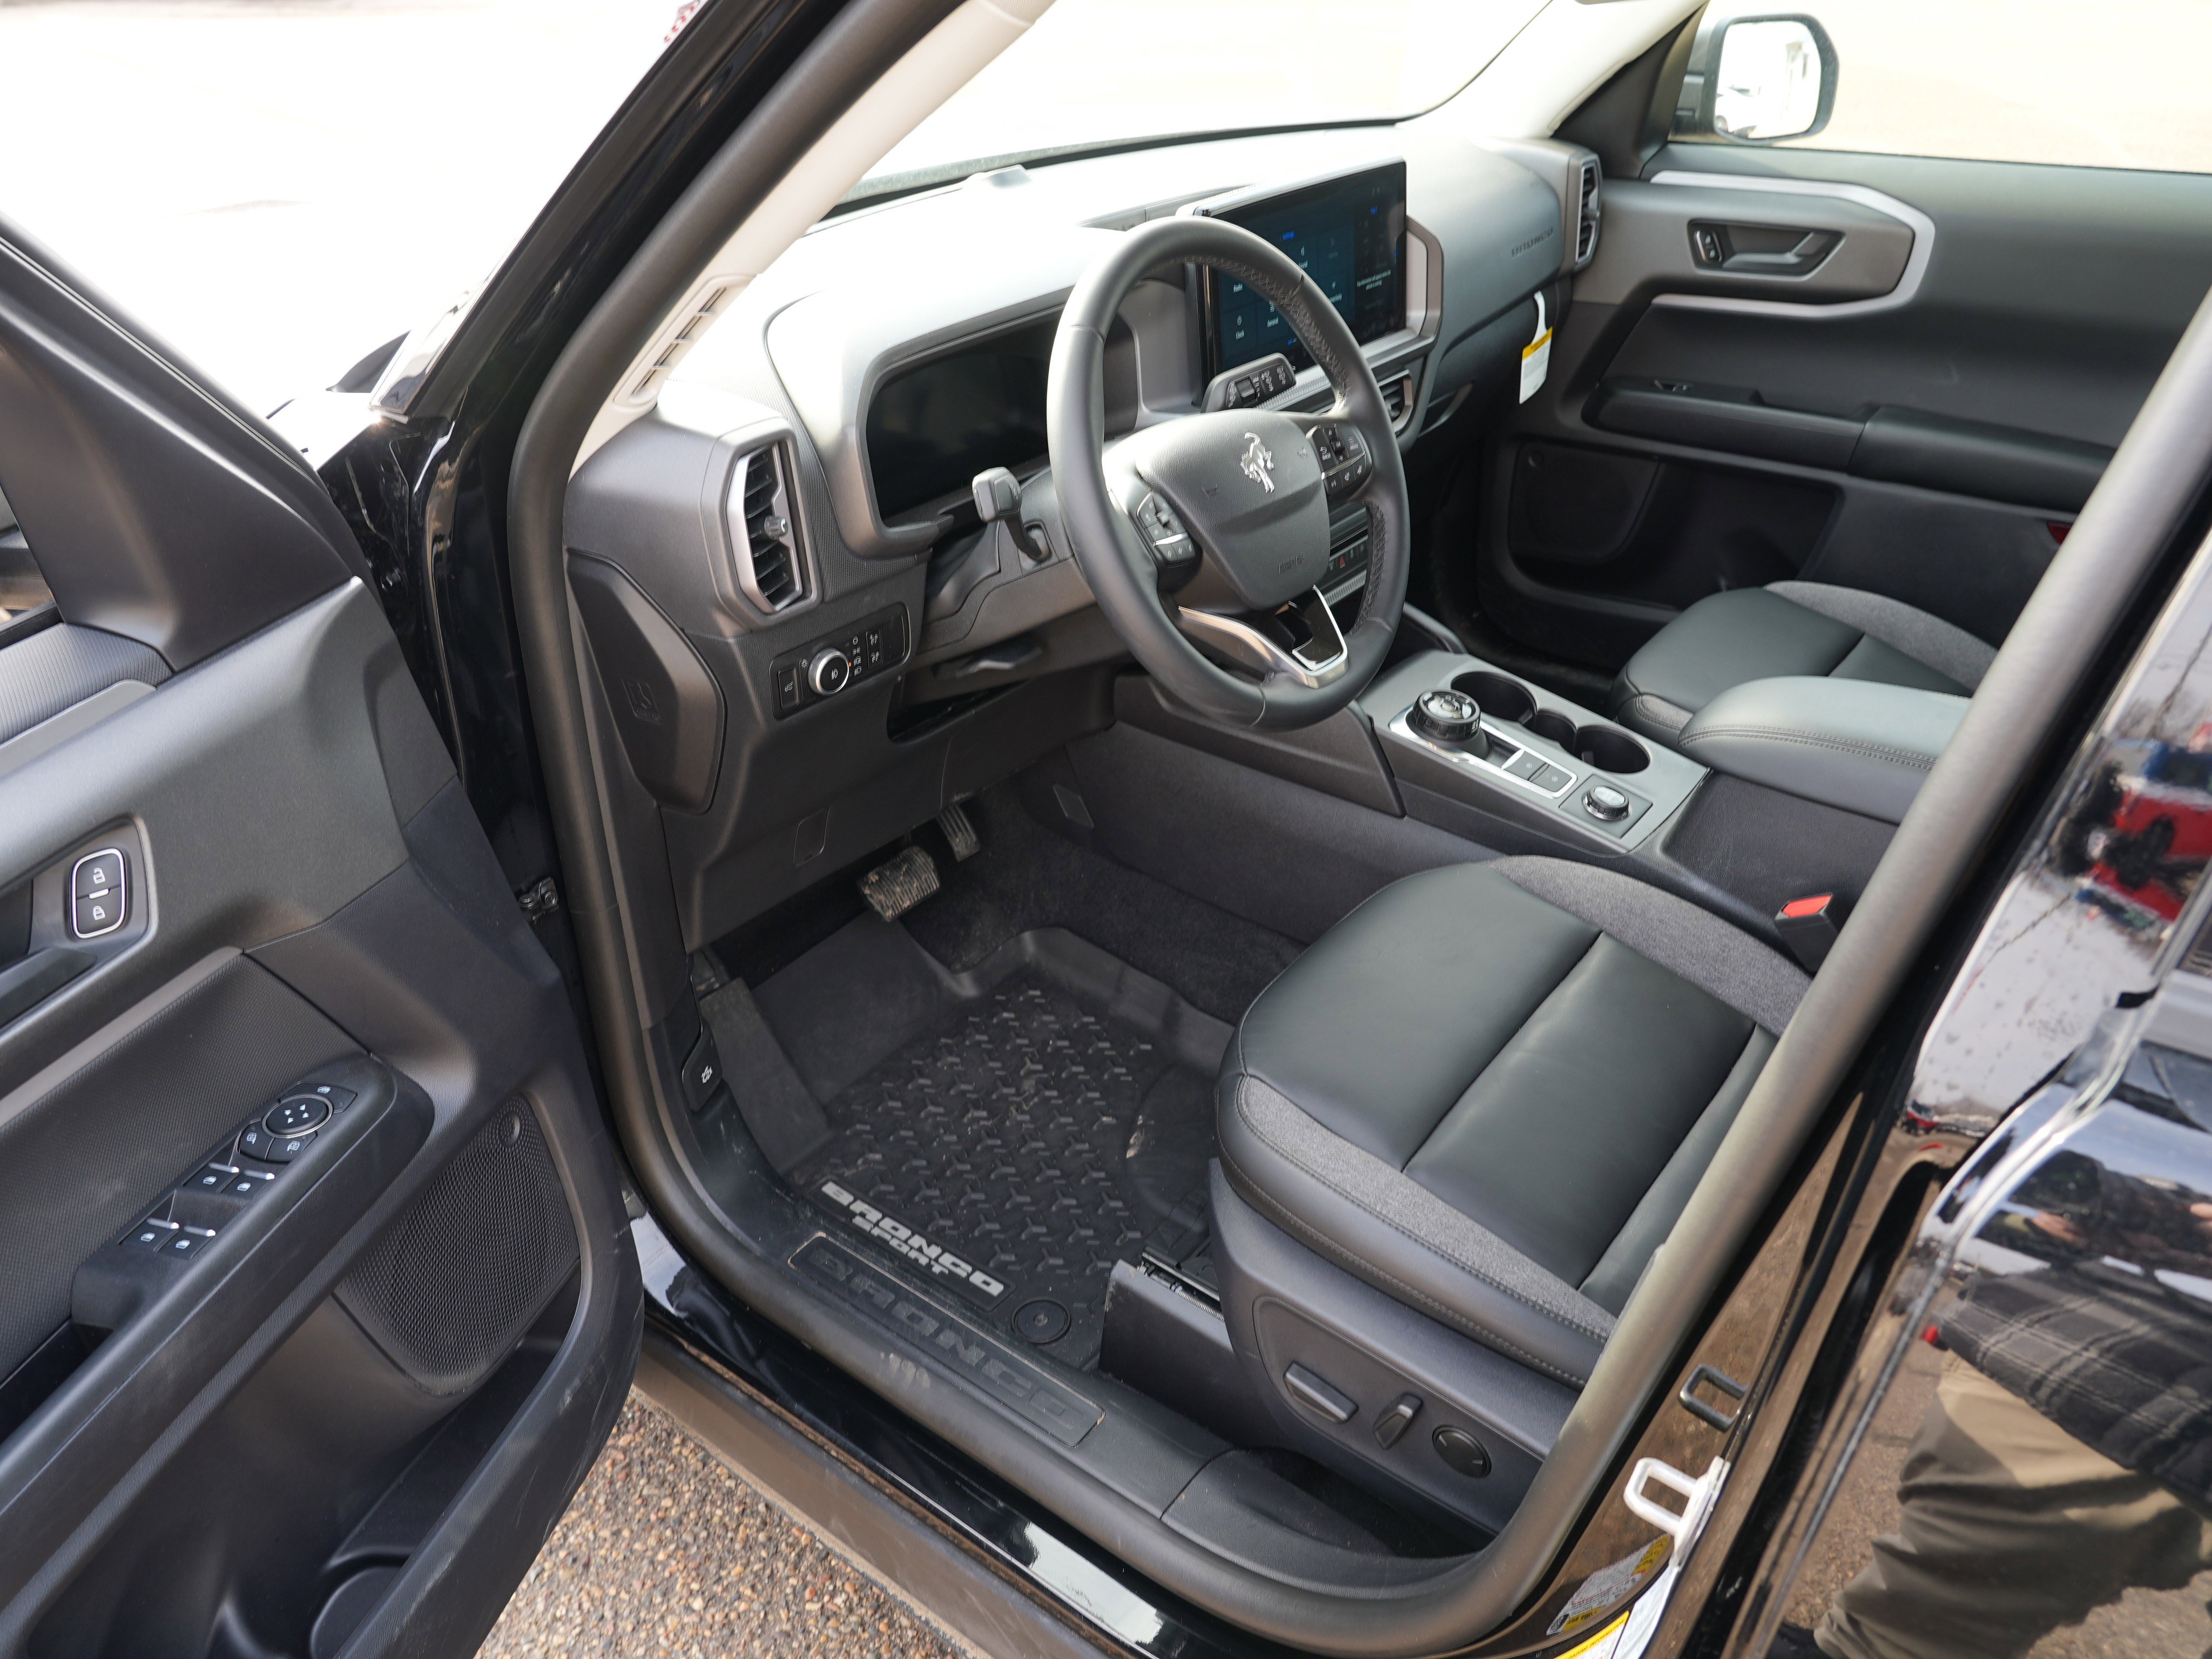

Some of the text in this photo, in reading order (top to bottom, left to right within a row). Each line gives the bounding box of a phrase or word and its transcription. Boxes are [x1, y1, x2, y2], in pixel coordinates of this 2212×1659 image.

[1512, 227, 1553, 257] BRONCO
[822, 1181, 1004, 1297] BRONCO
[852, 1215, 949, 1275] SPORT
[810, 1246, 1082, 1429] BRONCO
